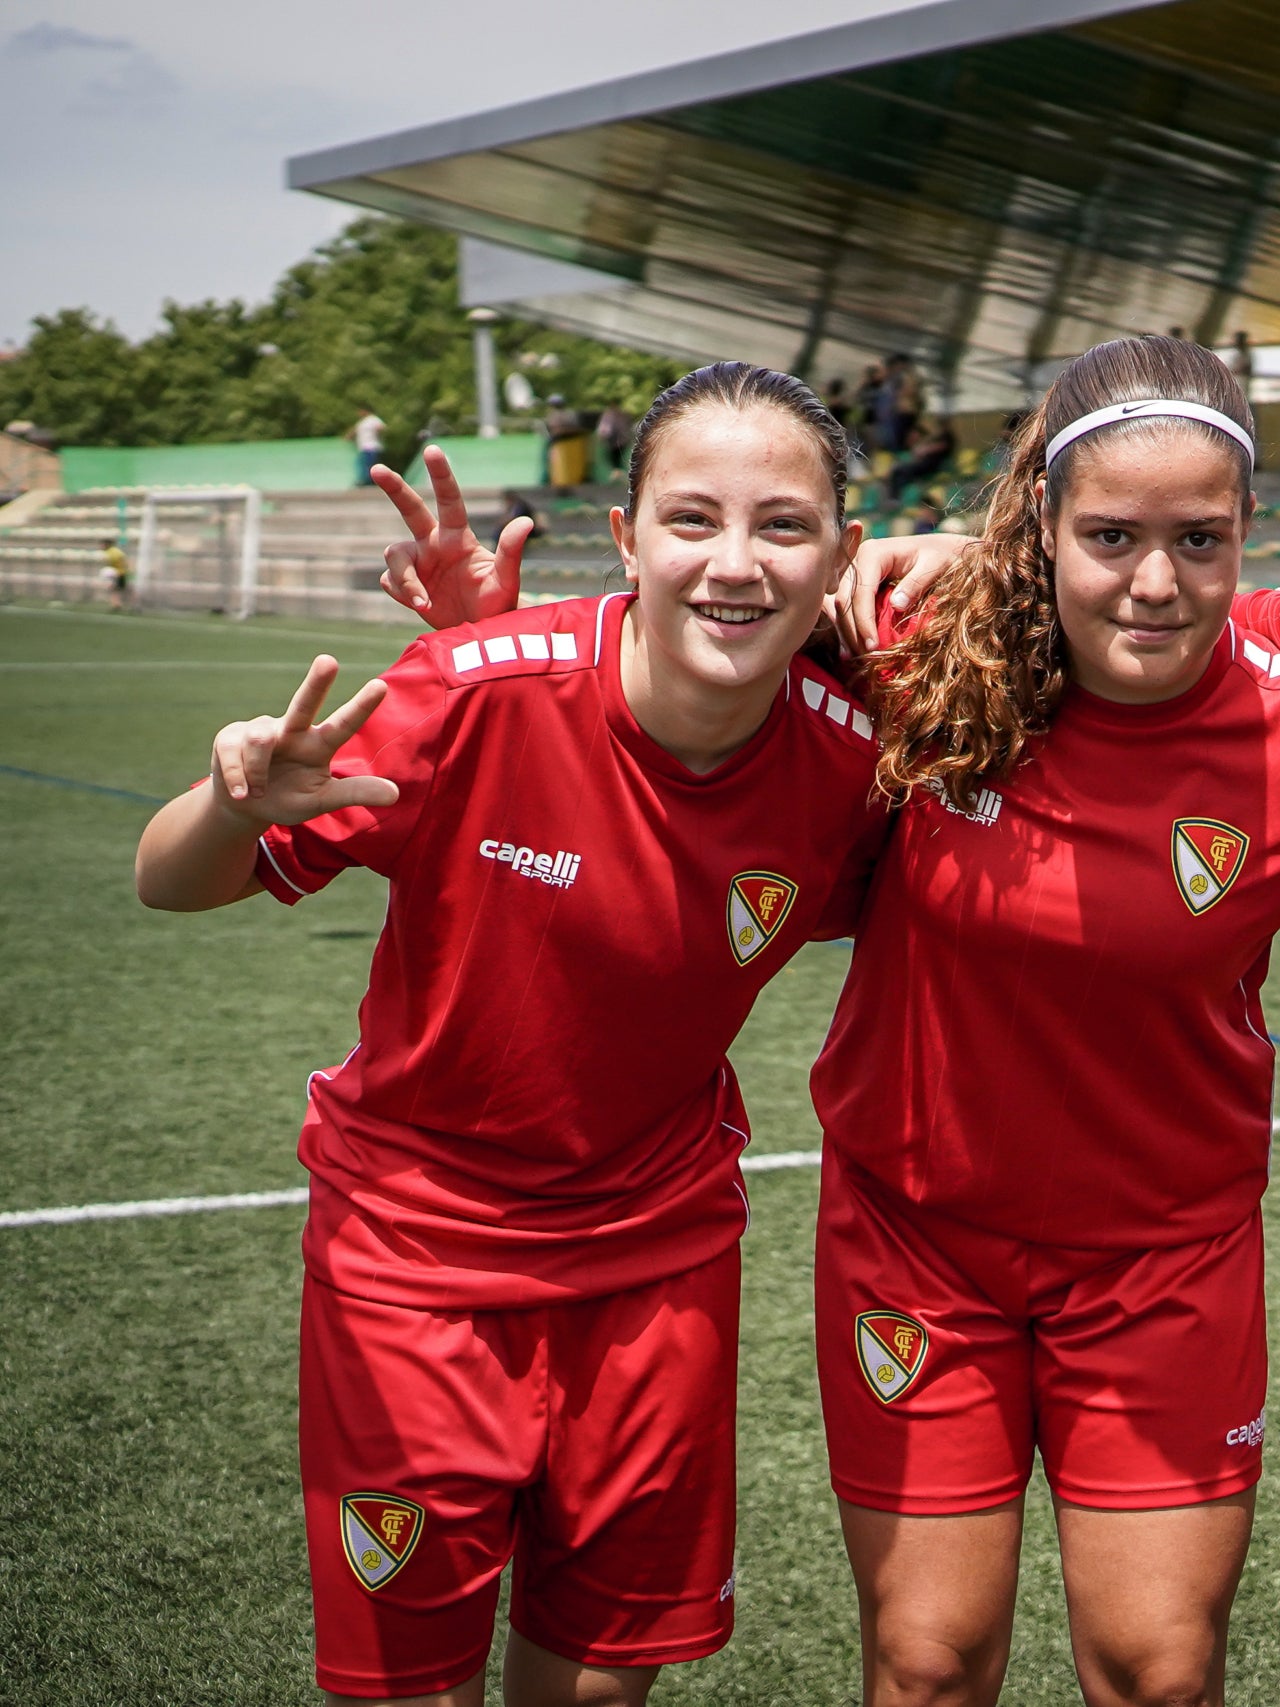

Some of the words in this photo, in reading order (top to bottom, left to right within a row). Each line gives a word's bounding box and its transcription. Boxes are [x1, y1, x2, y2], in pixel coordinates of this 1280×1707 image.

[945, 802, 997, 827] SPORT
[479, 839, 581, 880] capelli
[520, 866, 574, 889] SPORT
